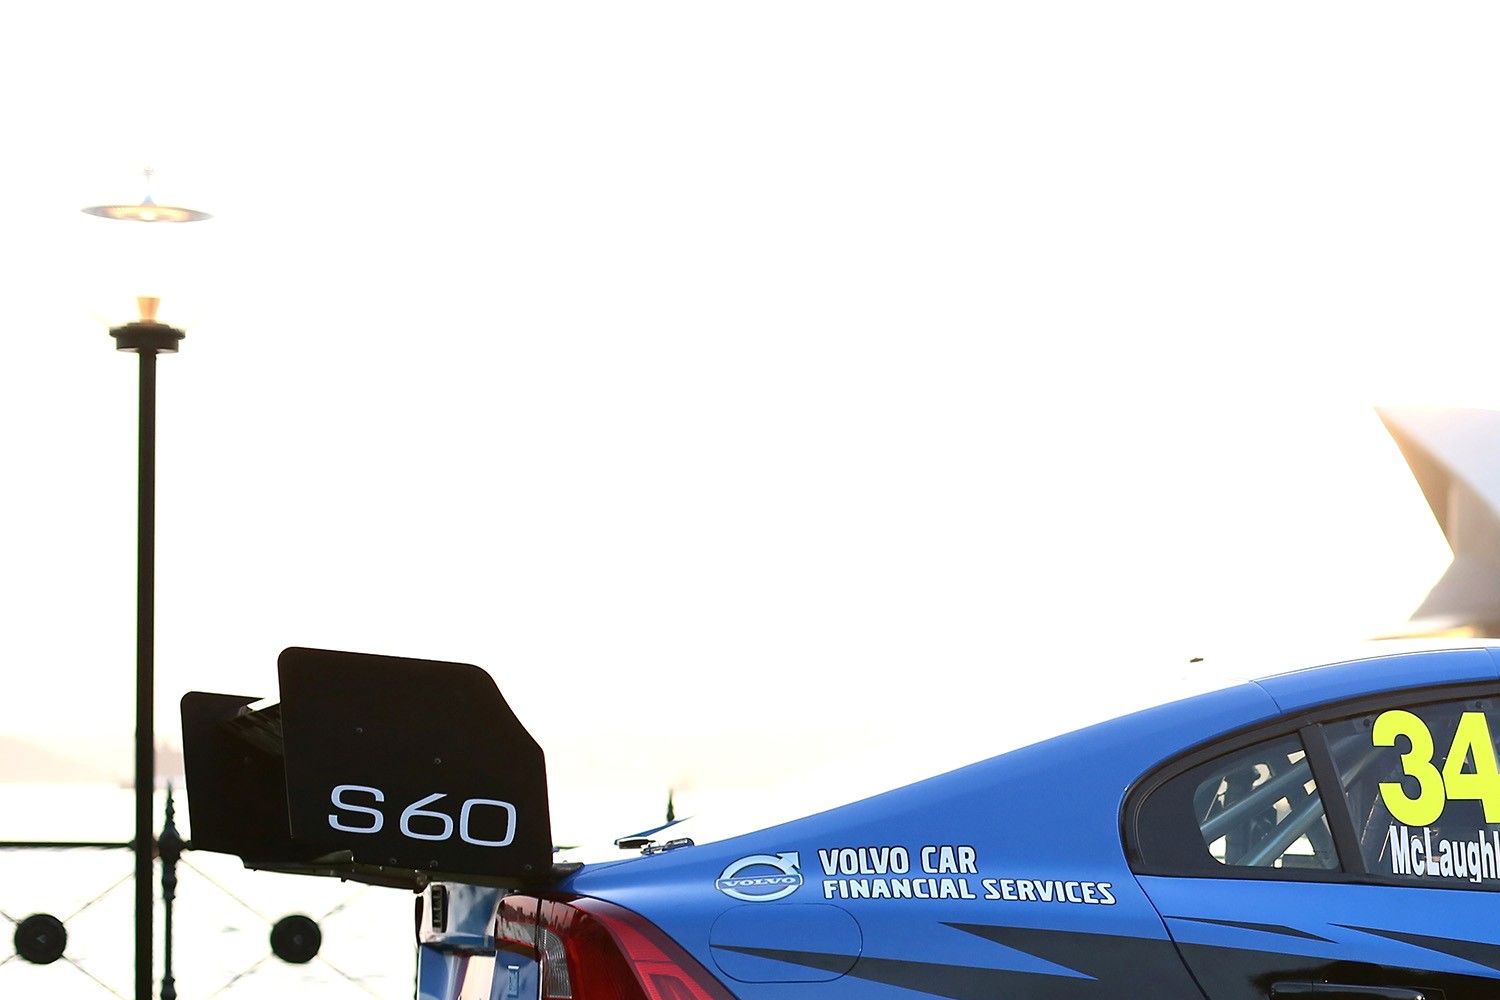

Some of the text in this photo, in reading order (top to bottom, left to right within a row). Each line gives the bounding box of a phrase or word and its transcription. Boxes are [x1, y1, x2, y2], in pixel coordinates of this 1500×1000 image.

[329, 784, 517, 847] S60
[819, 845, 979, 876] VOLVO CAR
[721, 876, 796, 888] VOLVO
[822, 877, 1117, 905] FINANCIAL SERVICES
